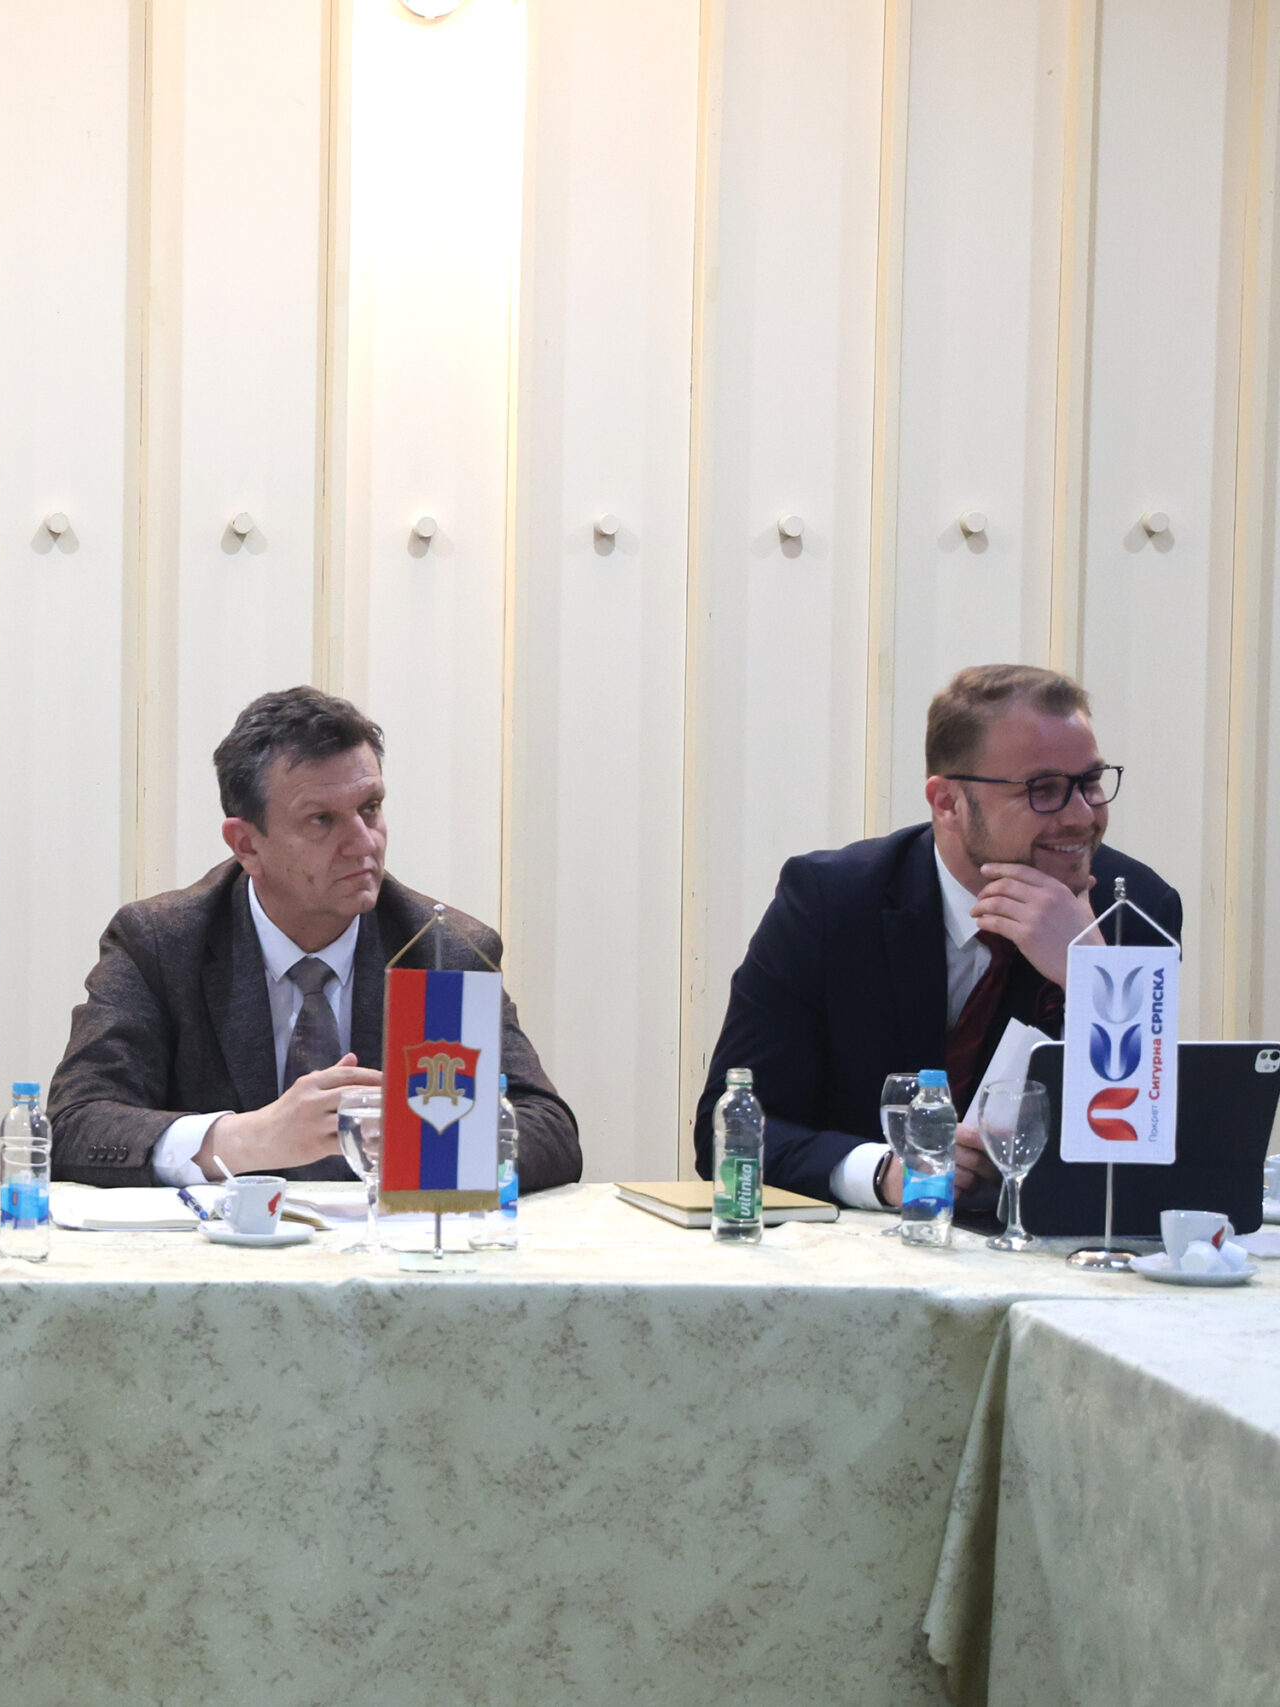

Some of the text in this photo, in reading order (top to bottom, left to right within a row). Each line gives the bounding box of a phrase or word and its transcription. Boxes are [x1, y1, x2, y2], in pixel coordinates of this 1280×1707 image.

[1151, 967, 1165, 1035] СРПСКА
[1148, 1037, 1163, 1101] Сигурна
[736, 1163, 753, 1217] vitinka
